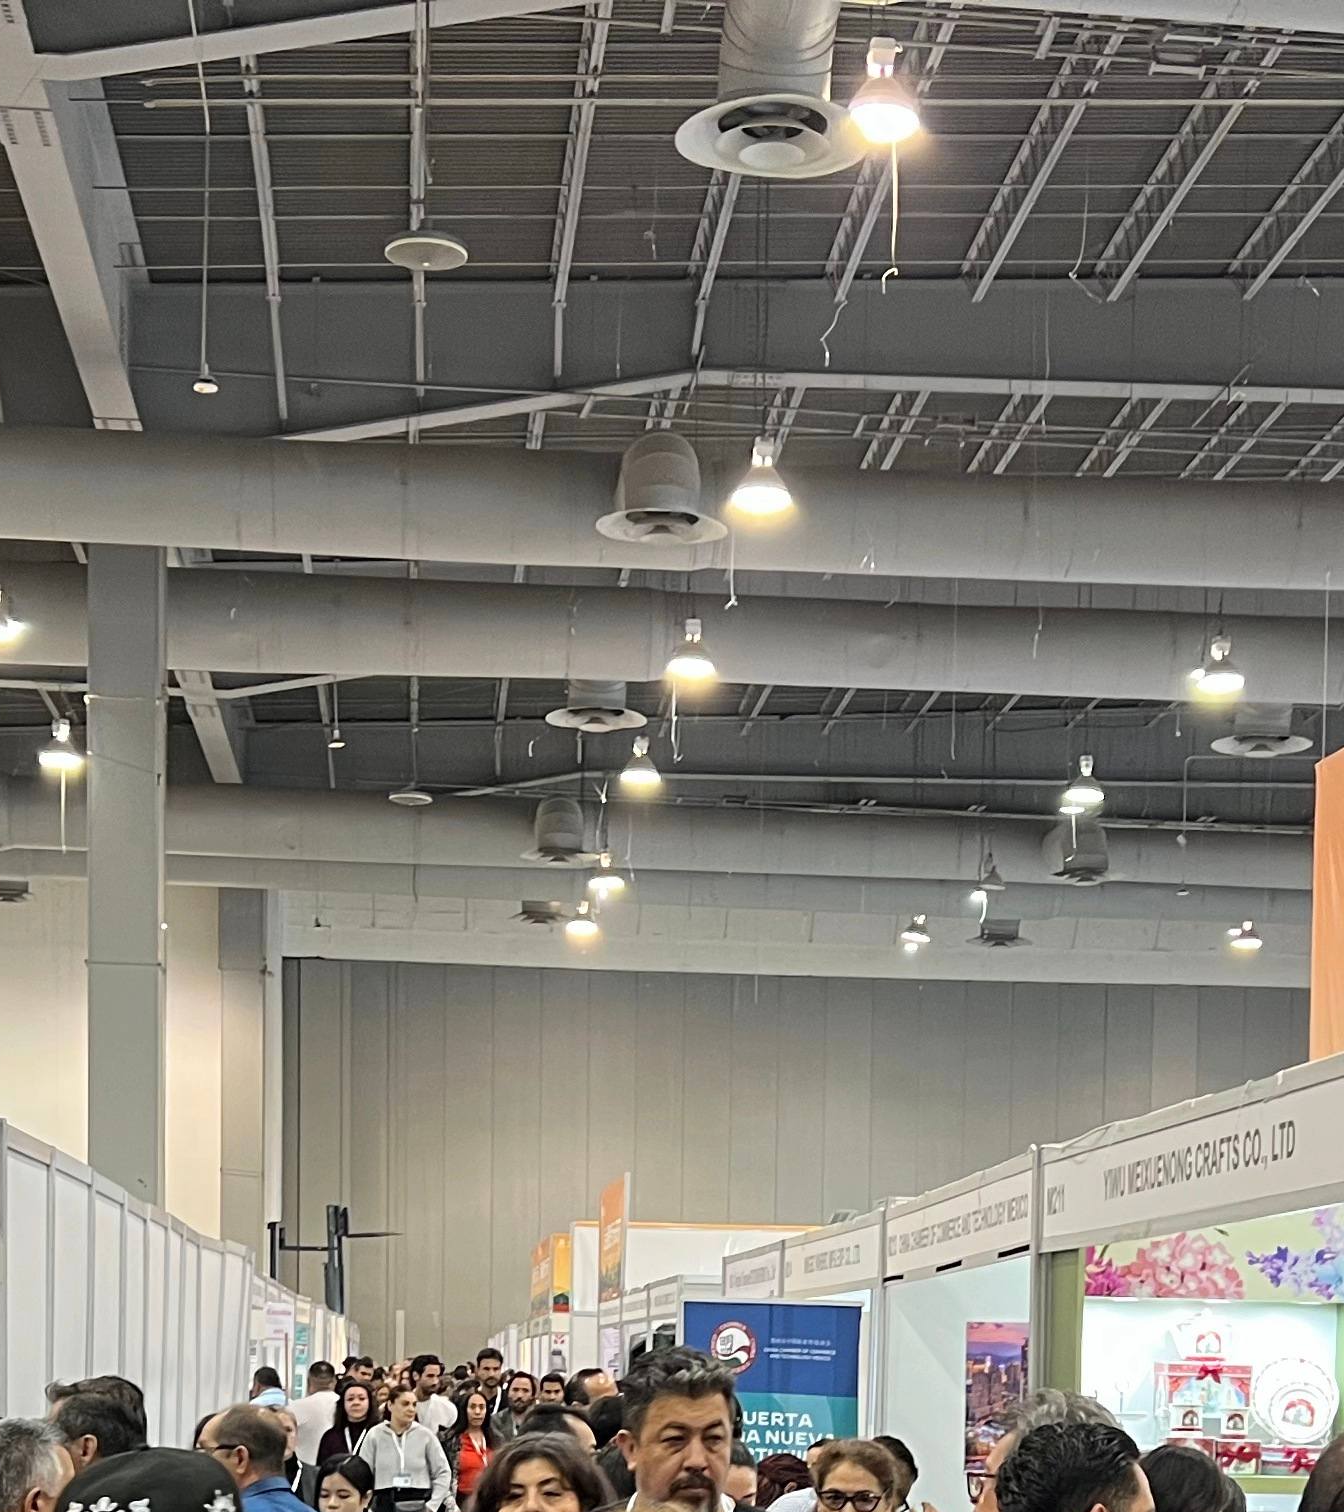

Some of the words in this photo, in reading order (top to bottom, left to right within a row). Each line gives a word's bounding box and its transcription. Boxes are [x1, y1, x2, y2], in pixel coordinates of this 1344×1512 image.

[1194, 1133, 1240, 1178] CRAFTS
[1272, 1120, 1297, 1162] LTD
[737, 1410, 813, 1428] UERTA
